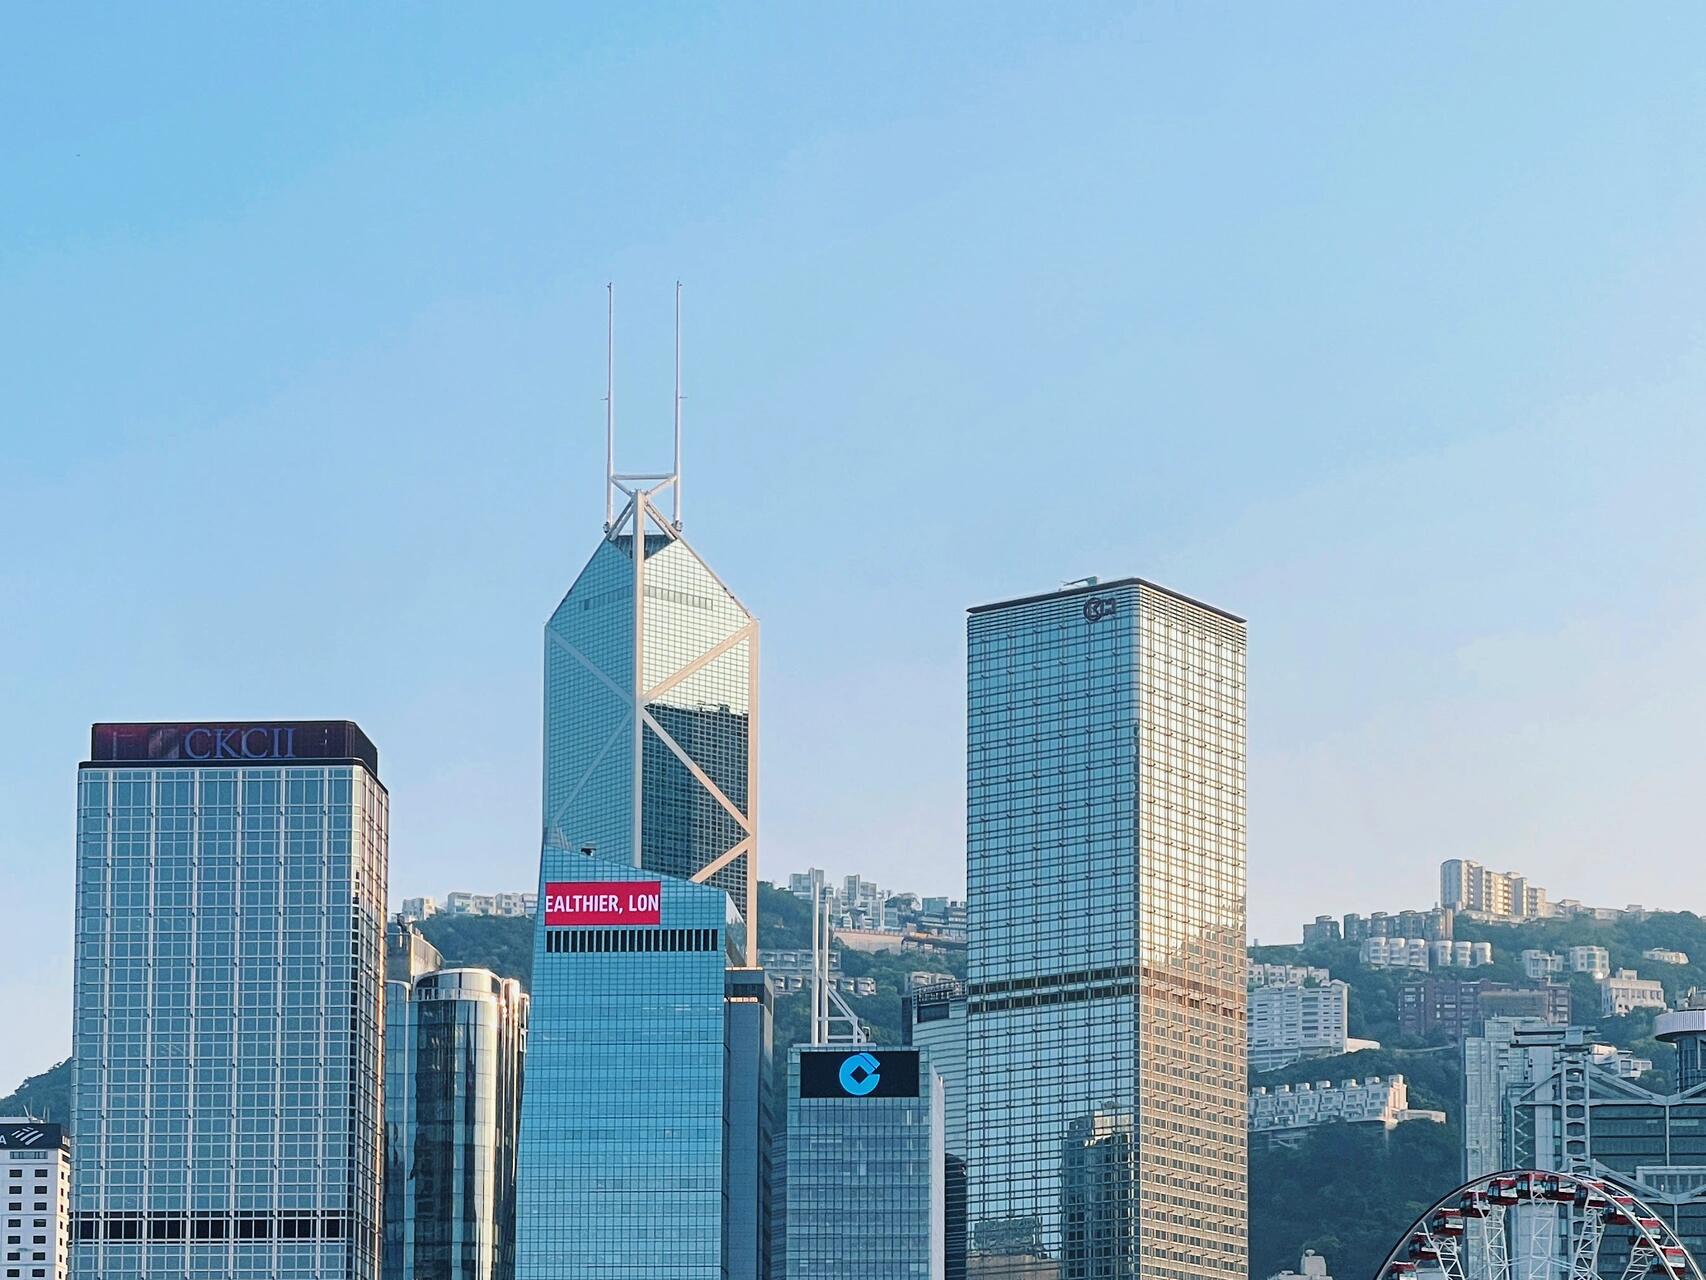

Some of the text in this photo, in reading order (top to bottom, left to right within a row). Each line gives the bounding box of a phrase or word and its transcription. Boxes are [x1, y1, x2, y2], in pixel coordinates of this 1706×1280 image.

[184, 727, 297, 759] CKCII
[545, 894, 659, 914] EALTHIER, LON
